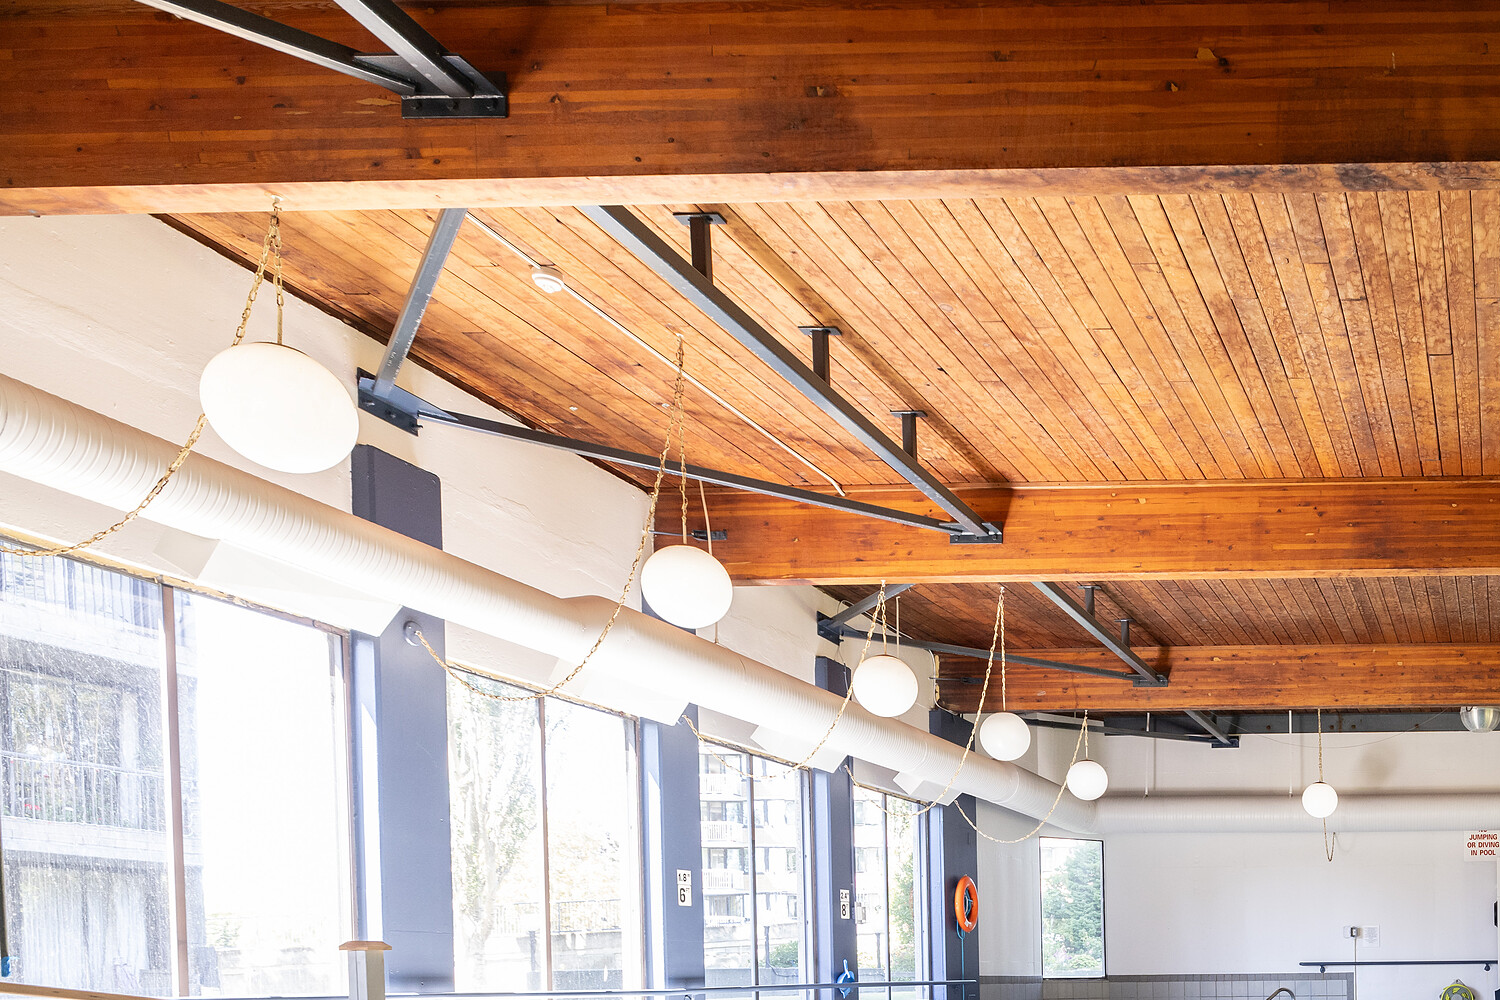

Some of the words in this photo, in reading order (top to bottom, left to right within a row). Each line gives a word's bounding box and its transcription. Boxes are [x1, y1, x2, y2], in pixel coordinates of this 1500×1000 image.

[1469, 833, 1498, 841] JUMPING
[679, 887, 686, 903] 6
[841, 903, 847, 917] 8
